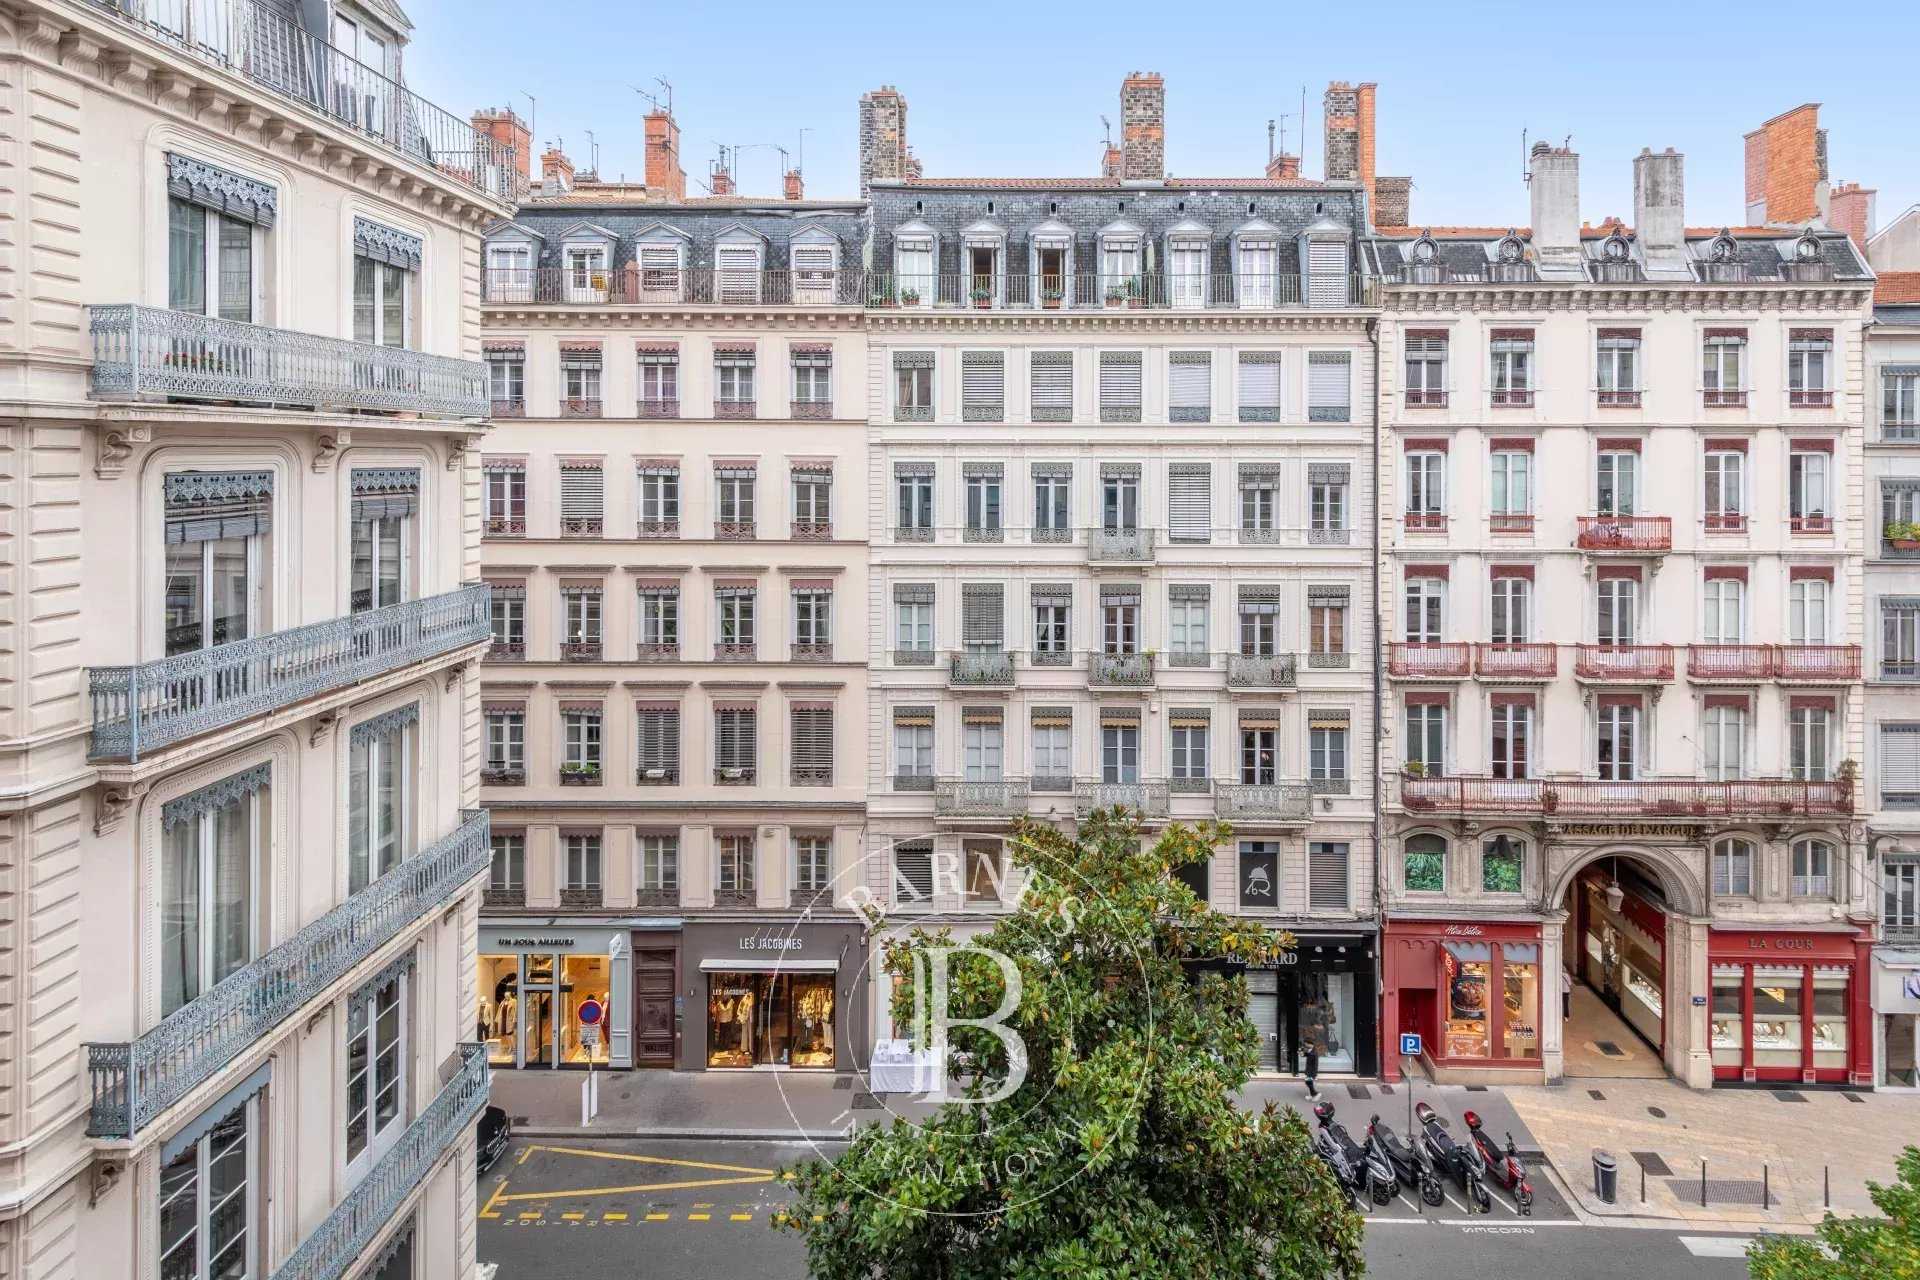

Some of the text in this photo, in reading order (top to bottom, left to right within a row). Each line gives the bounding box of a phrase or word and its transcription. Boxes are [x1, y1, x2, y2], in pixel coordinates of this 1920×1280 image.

[1621, 824, 1638, 836] DE
[740, 938, 802, 950] LES JACOBINES
[1750, 938, 1814, 949] LA COUR
